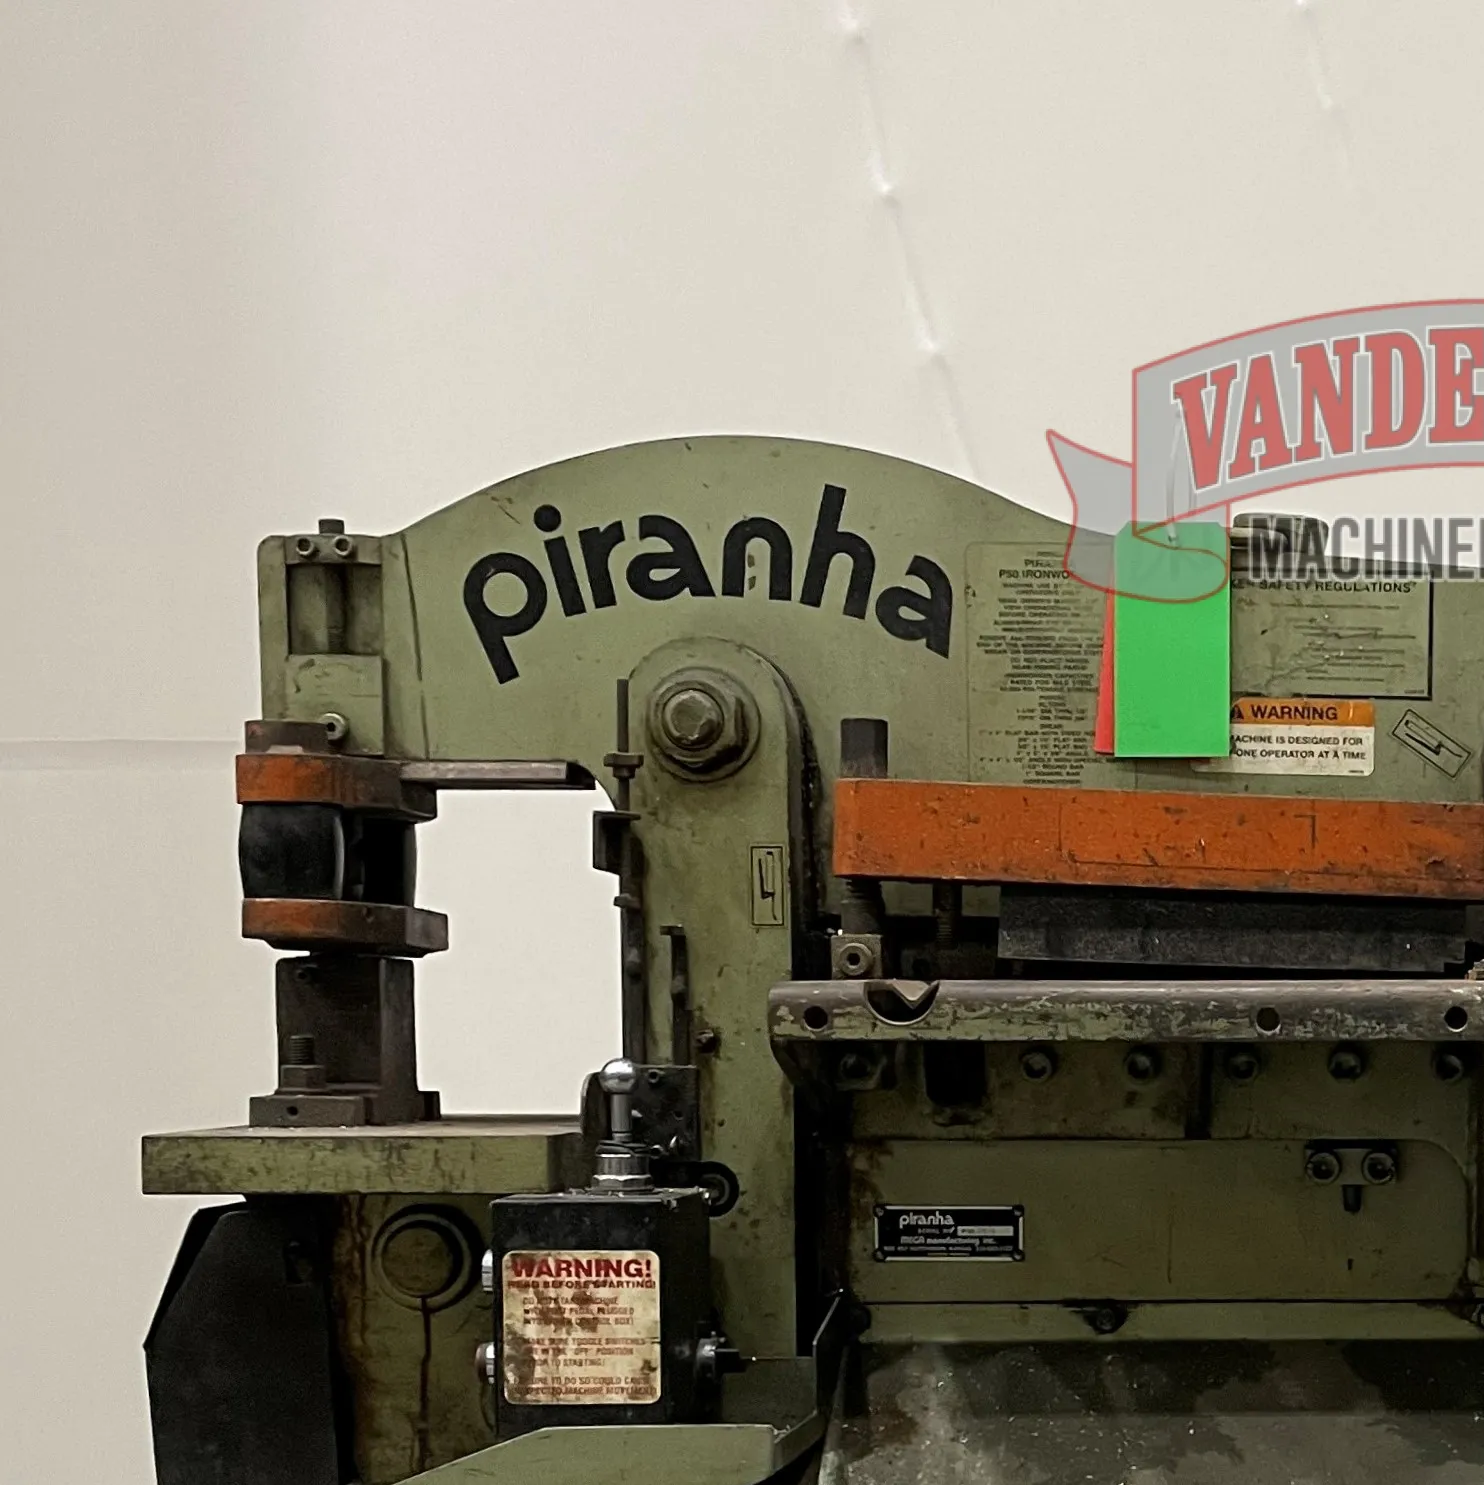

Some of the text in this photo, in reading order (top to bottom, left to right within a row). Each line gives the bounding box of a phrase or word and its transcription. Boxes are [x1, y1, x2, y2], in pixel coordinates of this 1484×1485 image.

[463, 484, 953, 685] piranha
[1260, 580, 1311, 591] SAFETY
[1250, 704, 1338, 720] WARNING
[1276, 736, 1285, 744] IS
[1288, 736, 1339, 745] DESIGNED
[1343, 737, 1363, 745] FOR
[1236, 750, 1256, 758] ONE
[1260, 750, 1315, 758] OPERATOR
[1317, 751, 1329, 759] AT
[900, 1211, 954, 1229] piranha
[511, 1258, 651, 1278] WARNING!
[543, 1280, 591, 1289] BEFORE
